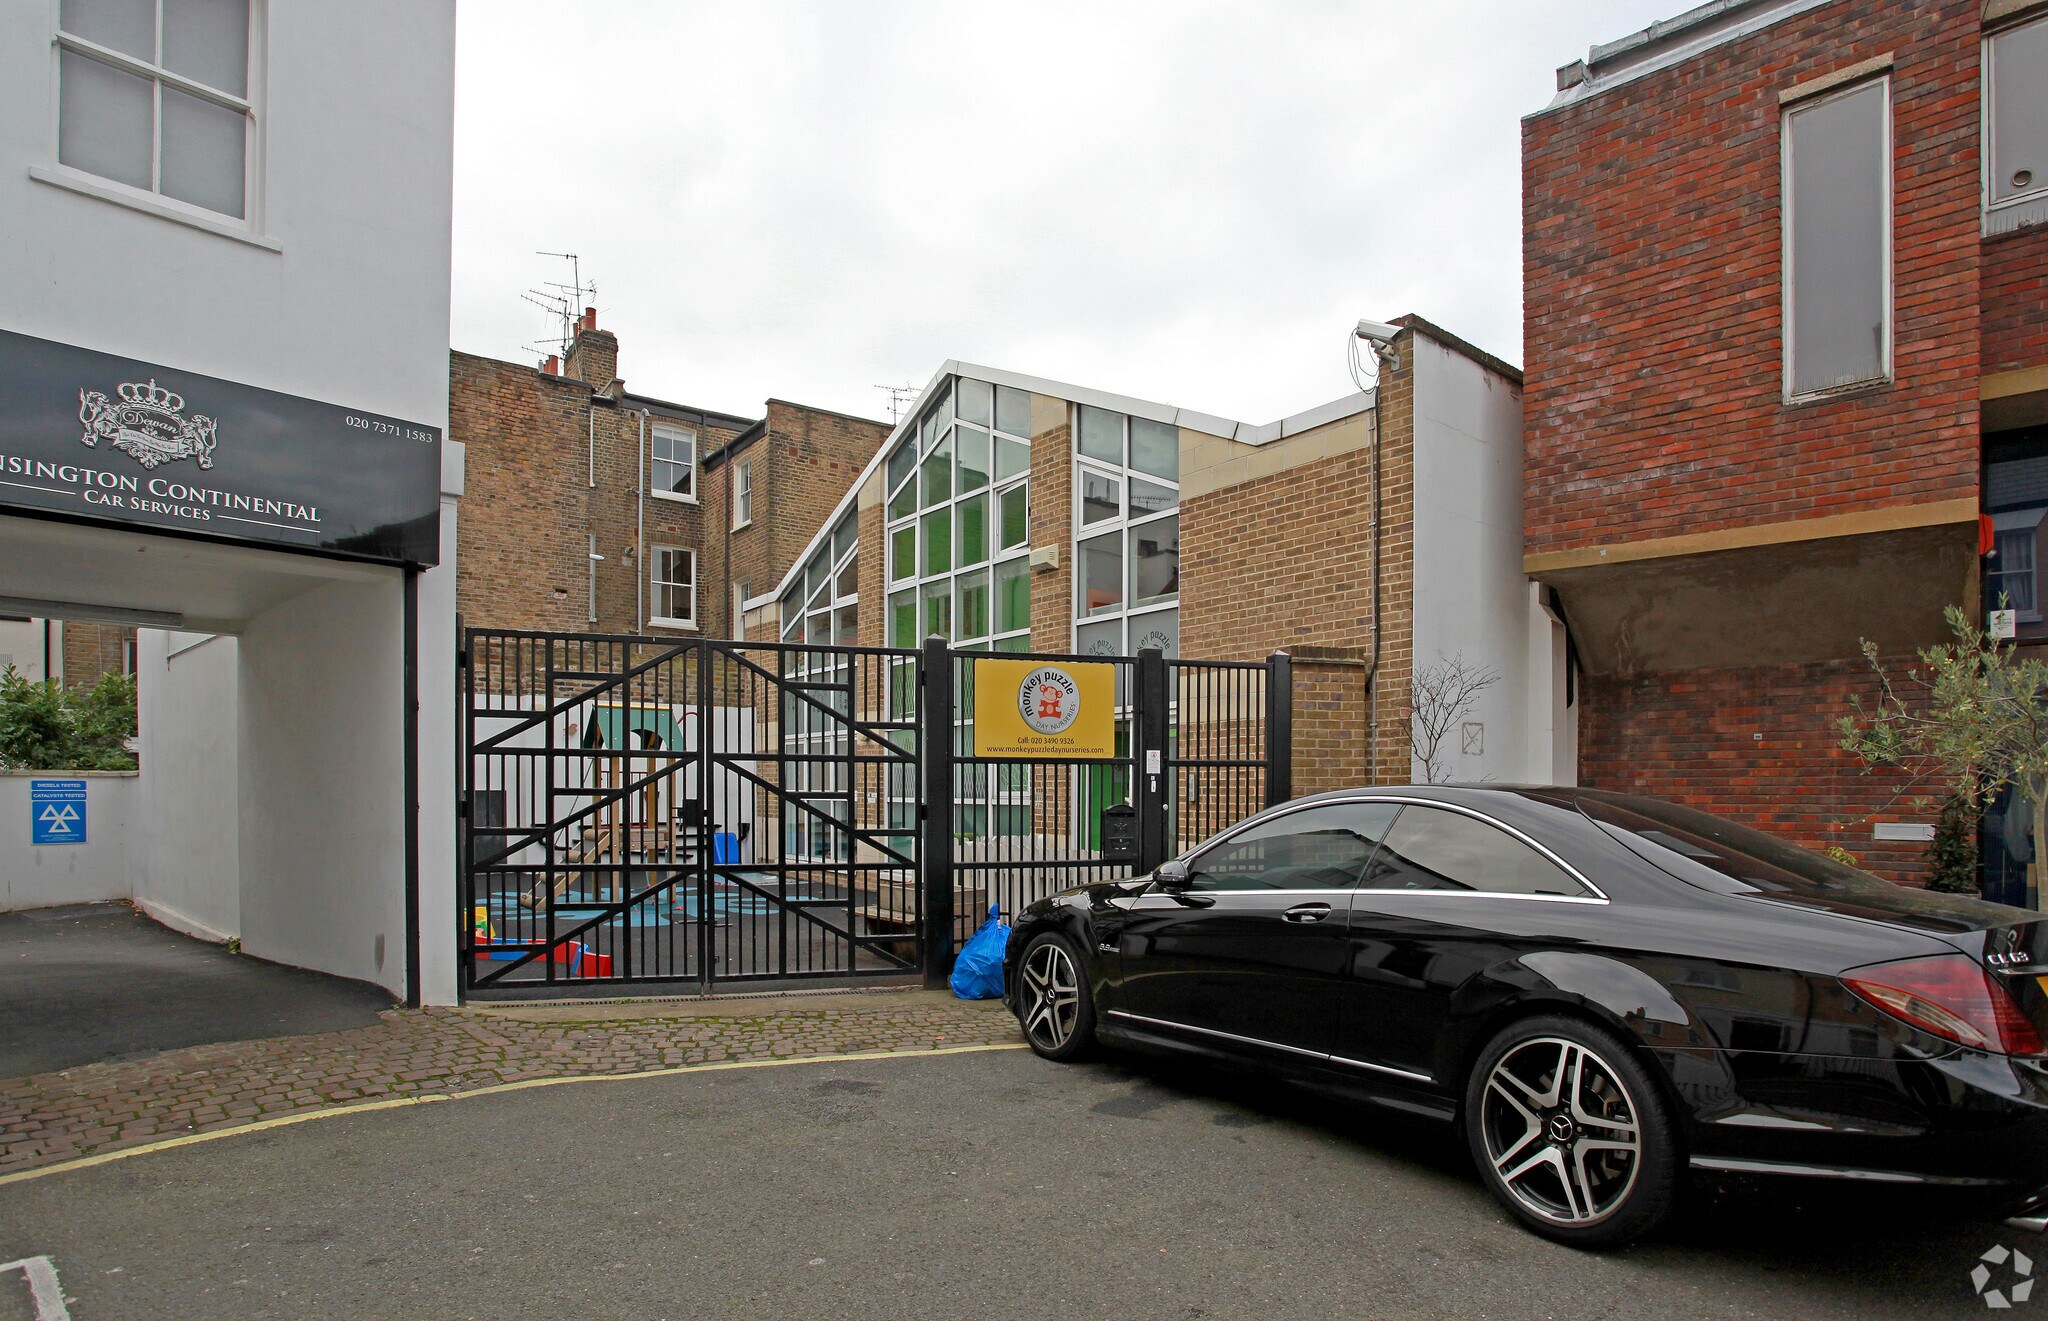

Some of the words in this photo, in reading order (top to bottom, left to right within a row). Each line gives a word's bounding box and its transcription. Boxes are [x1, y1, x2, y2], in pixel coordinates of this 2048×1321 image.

[119, 408, 179, 435] Dewan
[346, 415, 369, 429] 020
[372, 421, 400, 436] 7371
[405, 428, 433, 443] 1583
[83, 489, 125, 507] CAR
[130, 496, 211, 520] SERVICES
[148, 478, 322, 522] CONTINENTAL
[1022, 673, 1042, 717] monkey
[1044, 671, 1074, 695] puzzle
[1035, 721, 1049, 730] DAY
[1050, 702, 1076, 730] NURSERIES
[986, 745, 1105, 754] www.monkeypuzzledaynurseries.com
[1017, 736, 1030, 744] Call:
[1043, 737, 1059, 745] 3490
[1059, 737, 1075, 745] 9326
[1987, 953, 2009, 965] CL
